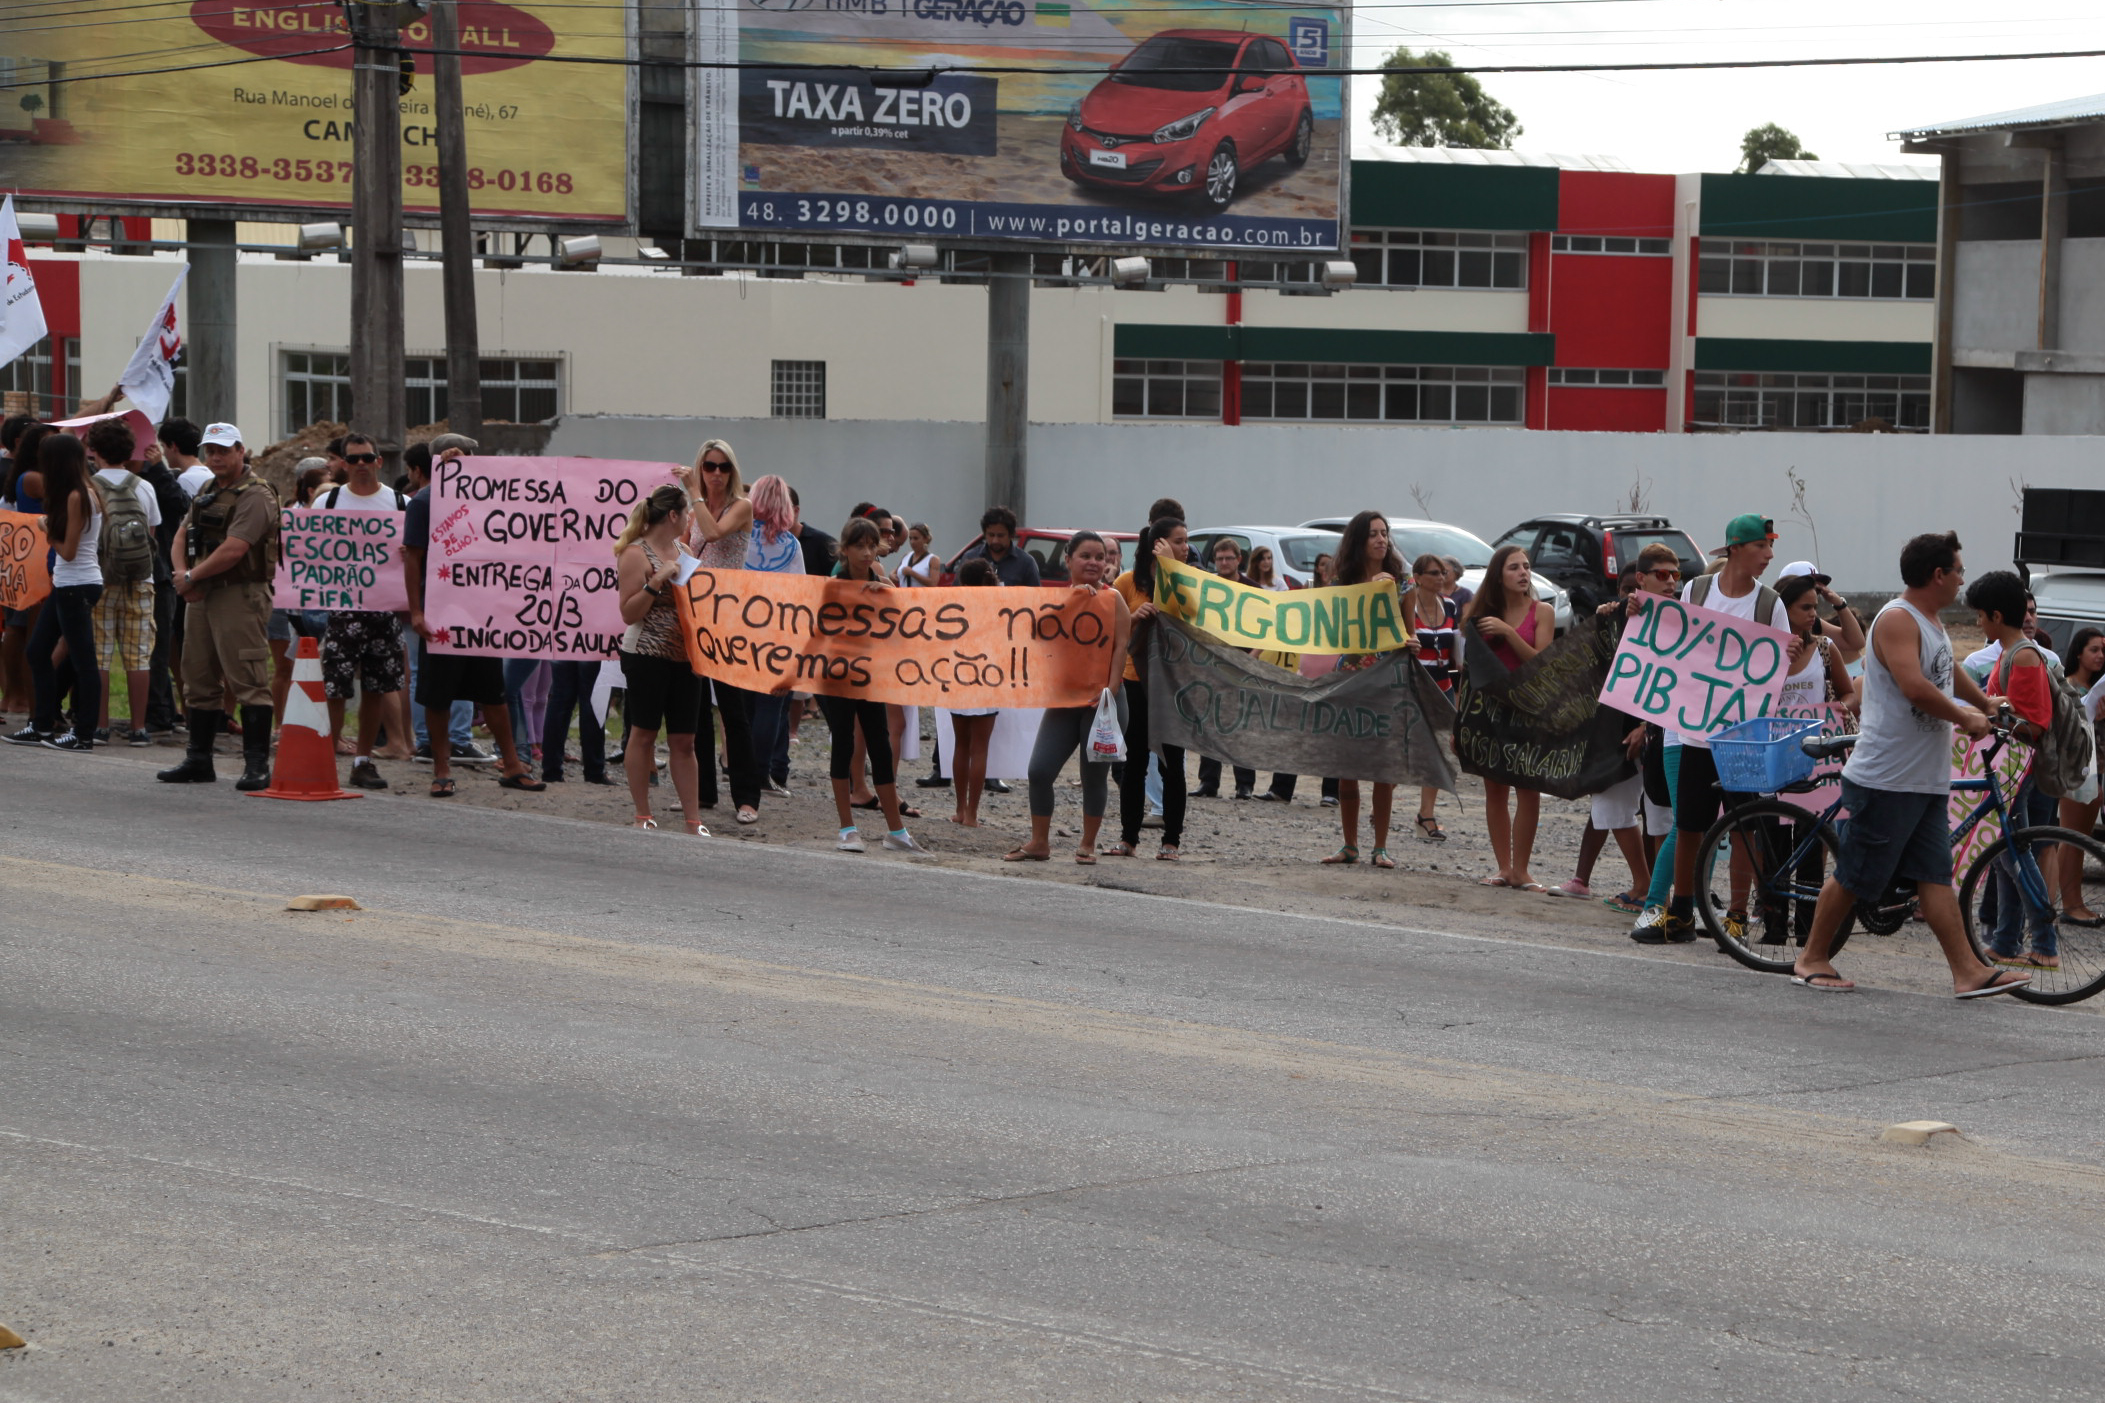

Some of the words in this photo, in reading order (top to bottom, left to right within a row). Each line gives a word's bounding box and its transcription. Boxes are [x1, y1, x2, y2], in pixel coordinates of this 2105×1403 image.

[461, 26, 520, 47] ALL
[234, 88, 266, 104] Rua
[272, 90, 337, 108] Manoel
[498, 105, 518, 119] 67
[767, 80, 864, 121] TAXA
[873, 88, 971, 128] ZERO
[831, 127, 837, 135] a
[838, 126, 863, 137] partir
[864, 126, 893, 138] 0,39%
[894, 130, 908, 139] cet
[175, 152, 354, 183] 3338-3537
[405, 165, 574, 194] 338-0168
[747, 202, 782, 221] 48.
[798, 200, 956, 228] 3298.0000
[988, 215, 1322, 245] www.portalgeracao.com.br
[435, 459, 567, 504] PROMESSA
[594, 479, 638, 505] DO
[280, 510, 397, 538] QUEREMOS
[431, 504, 469, 543] ESTAMOS
[483, 508, 628, 544] GOVERNO
[285, 535, 389, 565] ESCOLAS
[291, 560, 376, 588] PADRÃO
[452, 562, 553, 591] ENTREGA
[561, 574, 581, 591] DA
[686, 571, 969, 640] Promessas
[998, 603, 1110, 648] não,
[451, 615, 527, 649] INÍCIO
[528, 629, 568, 653] DAS
[1627, 597, 1716, 660] 10%
[1715, 627, 1781, 685] DO
[697, 627, 872, 687] Queremos
[895, 646, 1029, 692] ação!!
[1606, 652, 1678, 714] PIB
